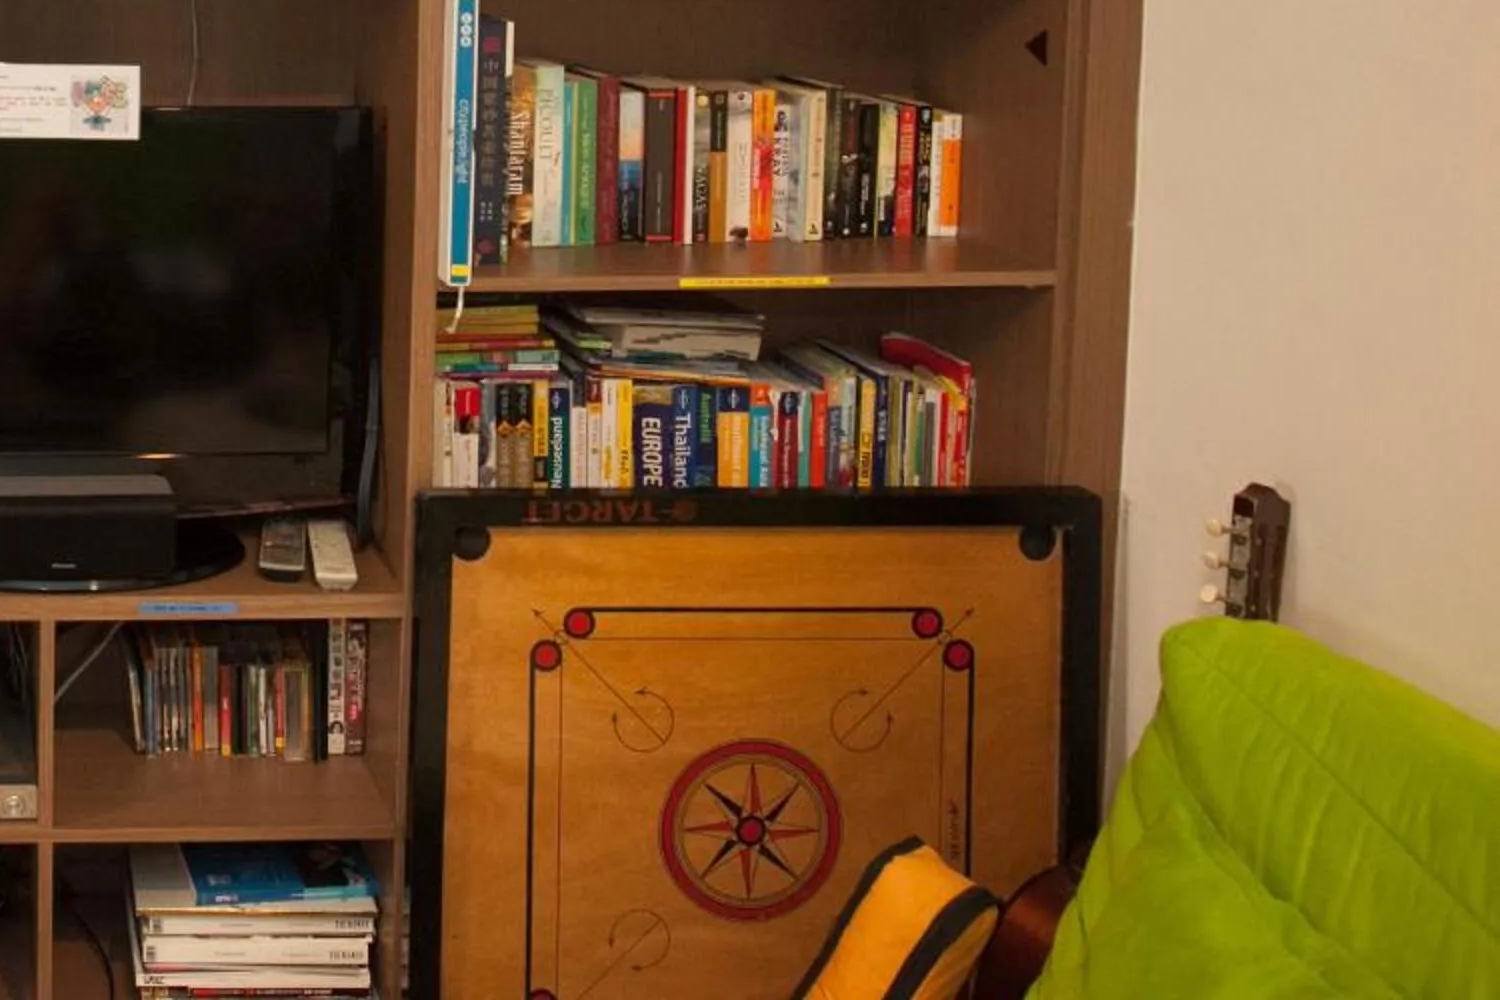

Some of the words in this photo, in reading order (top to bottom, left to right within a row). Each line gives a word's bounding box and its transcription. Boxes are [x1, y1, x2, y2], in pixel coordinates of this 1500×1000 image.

[538, 88, 555, 161] PICOULT
[641, 416, 664, 488] EUROPE
[519, 500, 659, 524] TARGET
